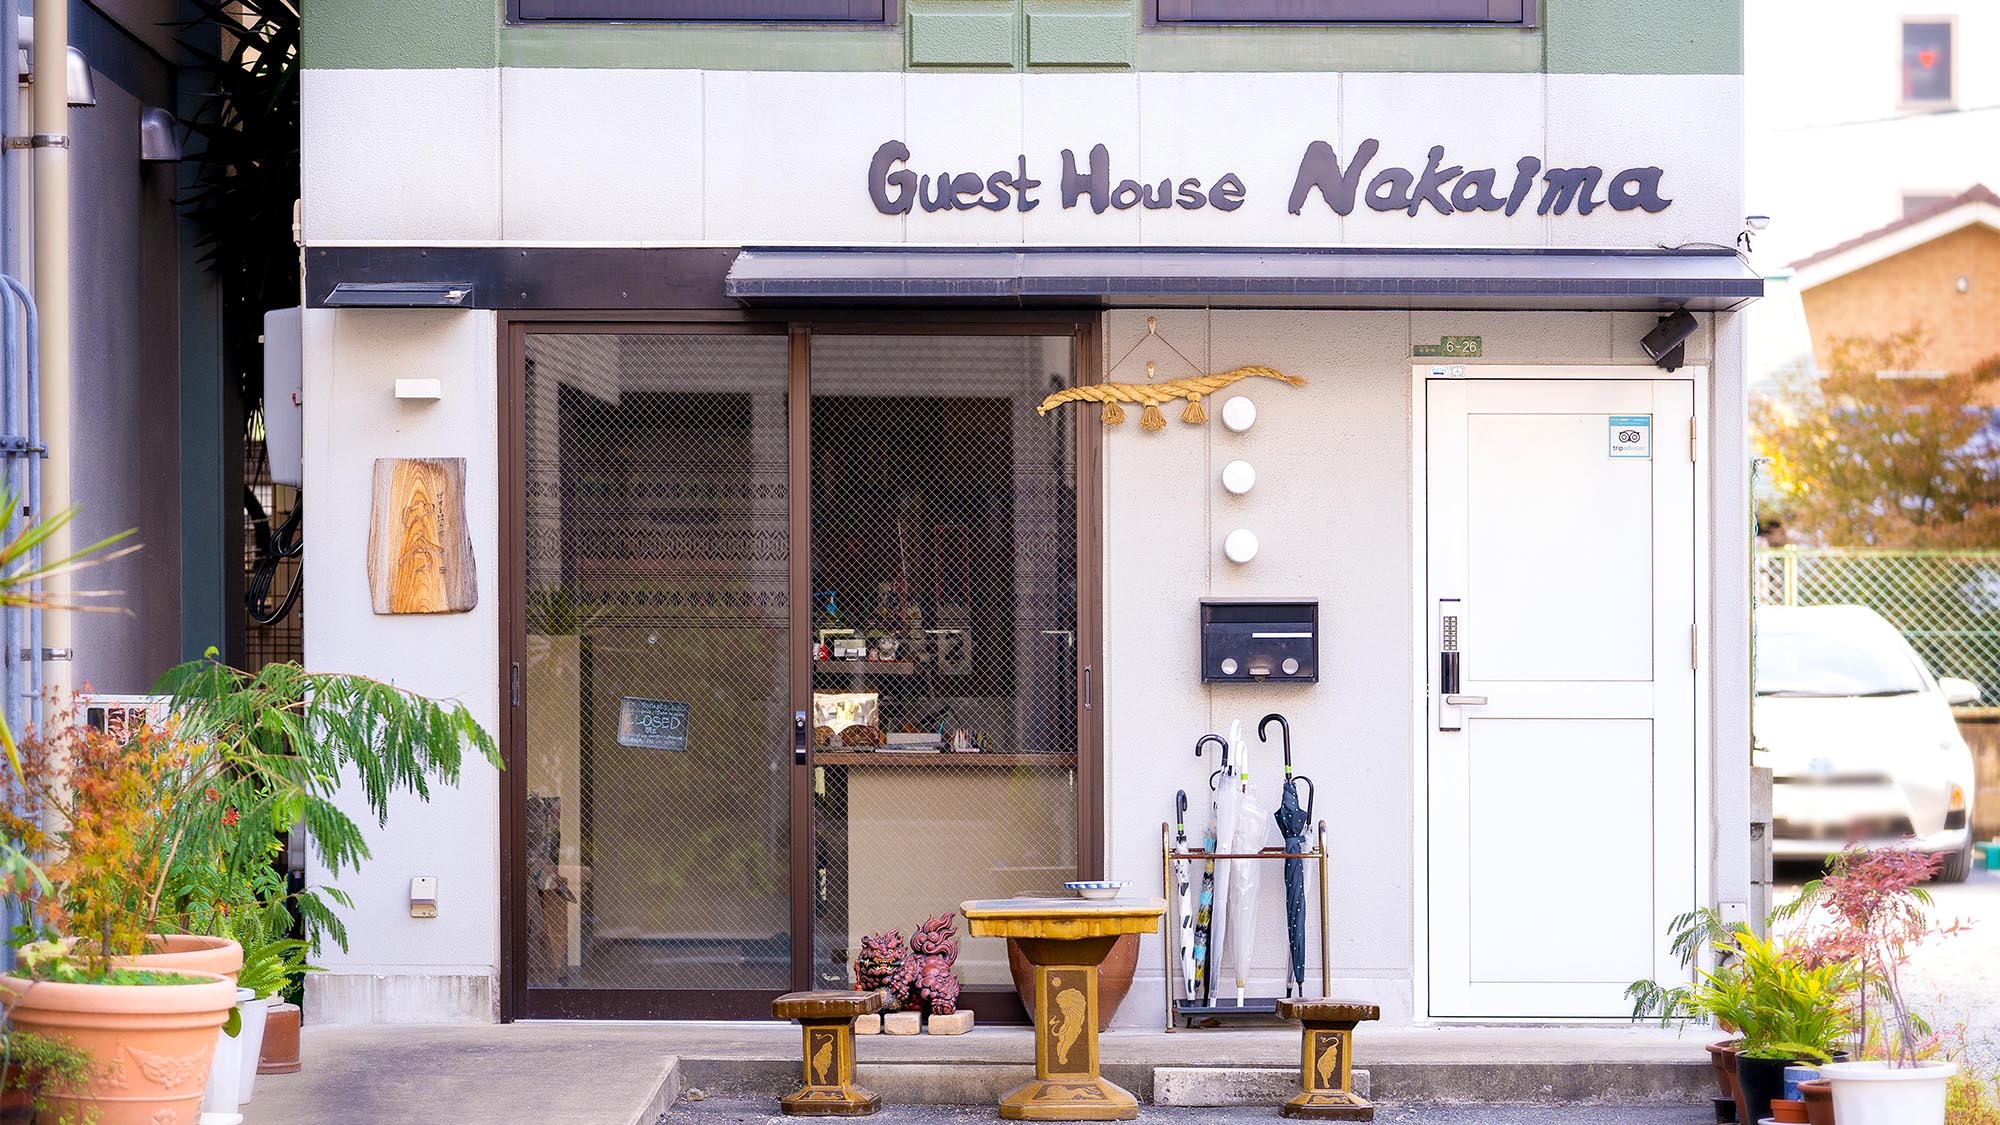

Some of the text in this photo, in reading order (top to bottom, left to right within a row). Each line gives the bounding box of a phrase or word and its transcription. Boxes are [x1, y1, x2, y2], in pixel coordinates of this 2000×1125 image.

[867, 137, 1674, 218] Guest House Nakaima
[1446, 340, 1477, 353] 6-26
